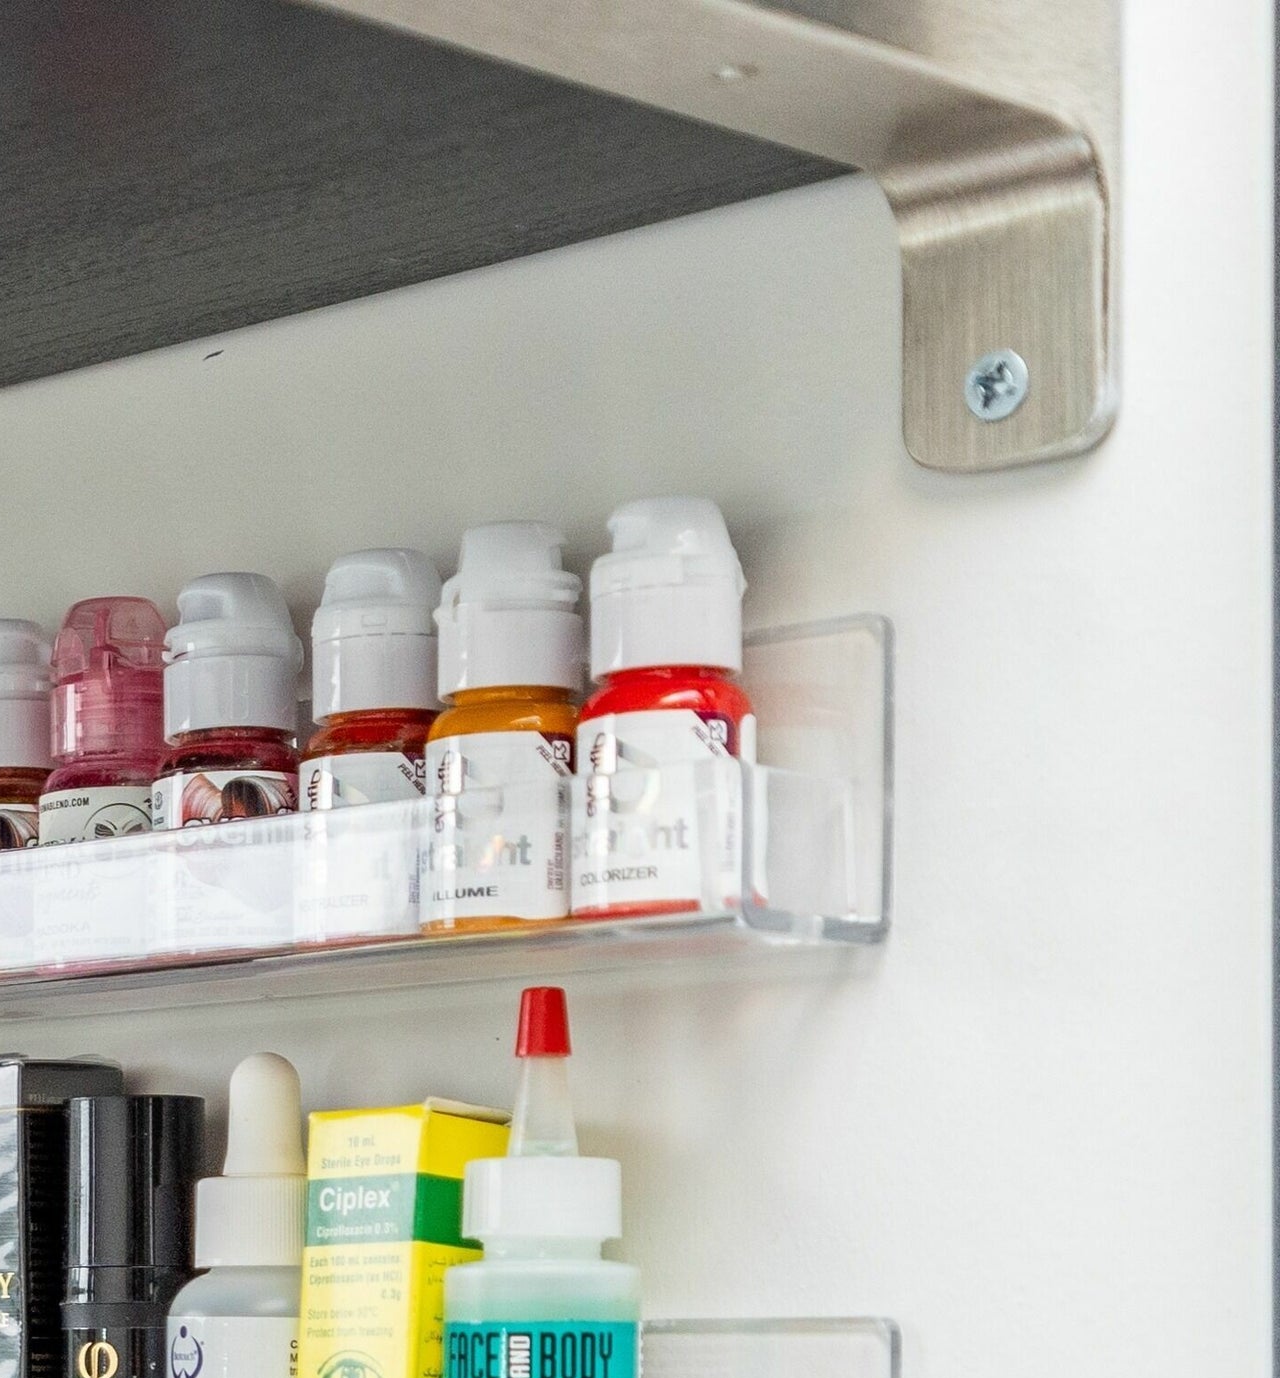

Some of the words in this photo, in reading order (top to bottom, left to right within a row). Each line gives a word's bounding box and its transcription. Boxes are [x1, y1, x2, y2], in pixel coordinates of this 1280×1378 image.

[580, 865, 658, 887] COLORIZER
[433, 885, 499, 902] ILLUME
[321, 1157, 351, 1170] Sterile
[355, 1155, 370, 1168] Eye
